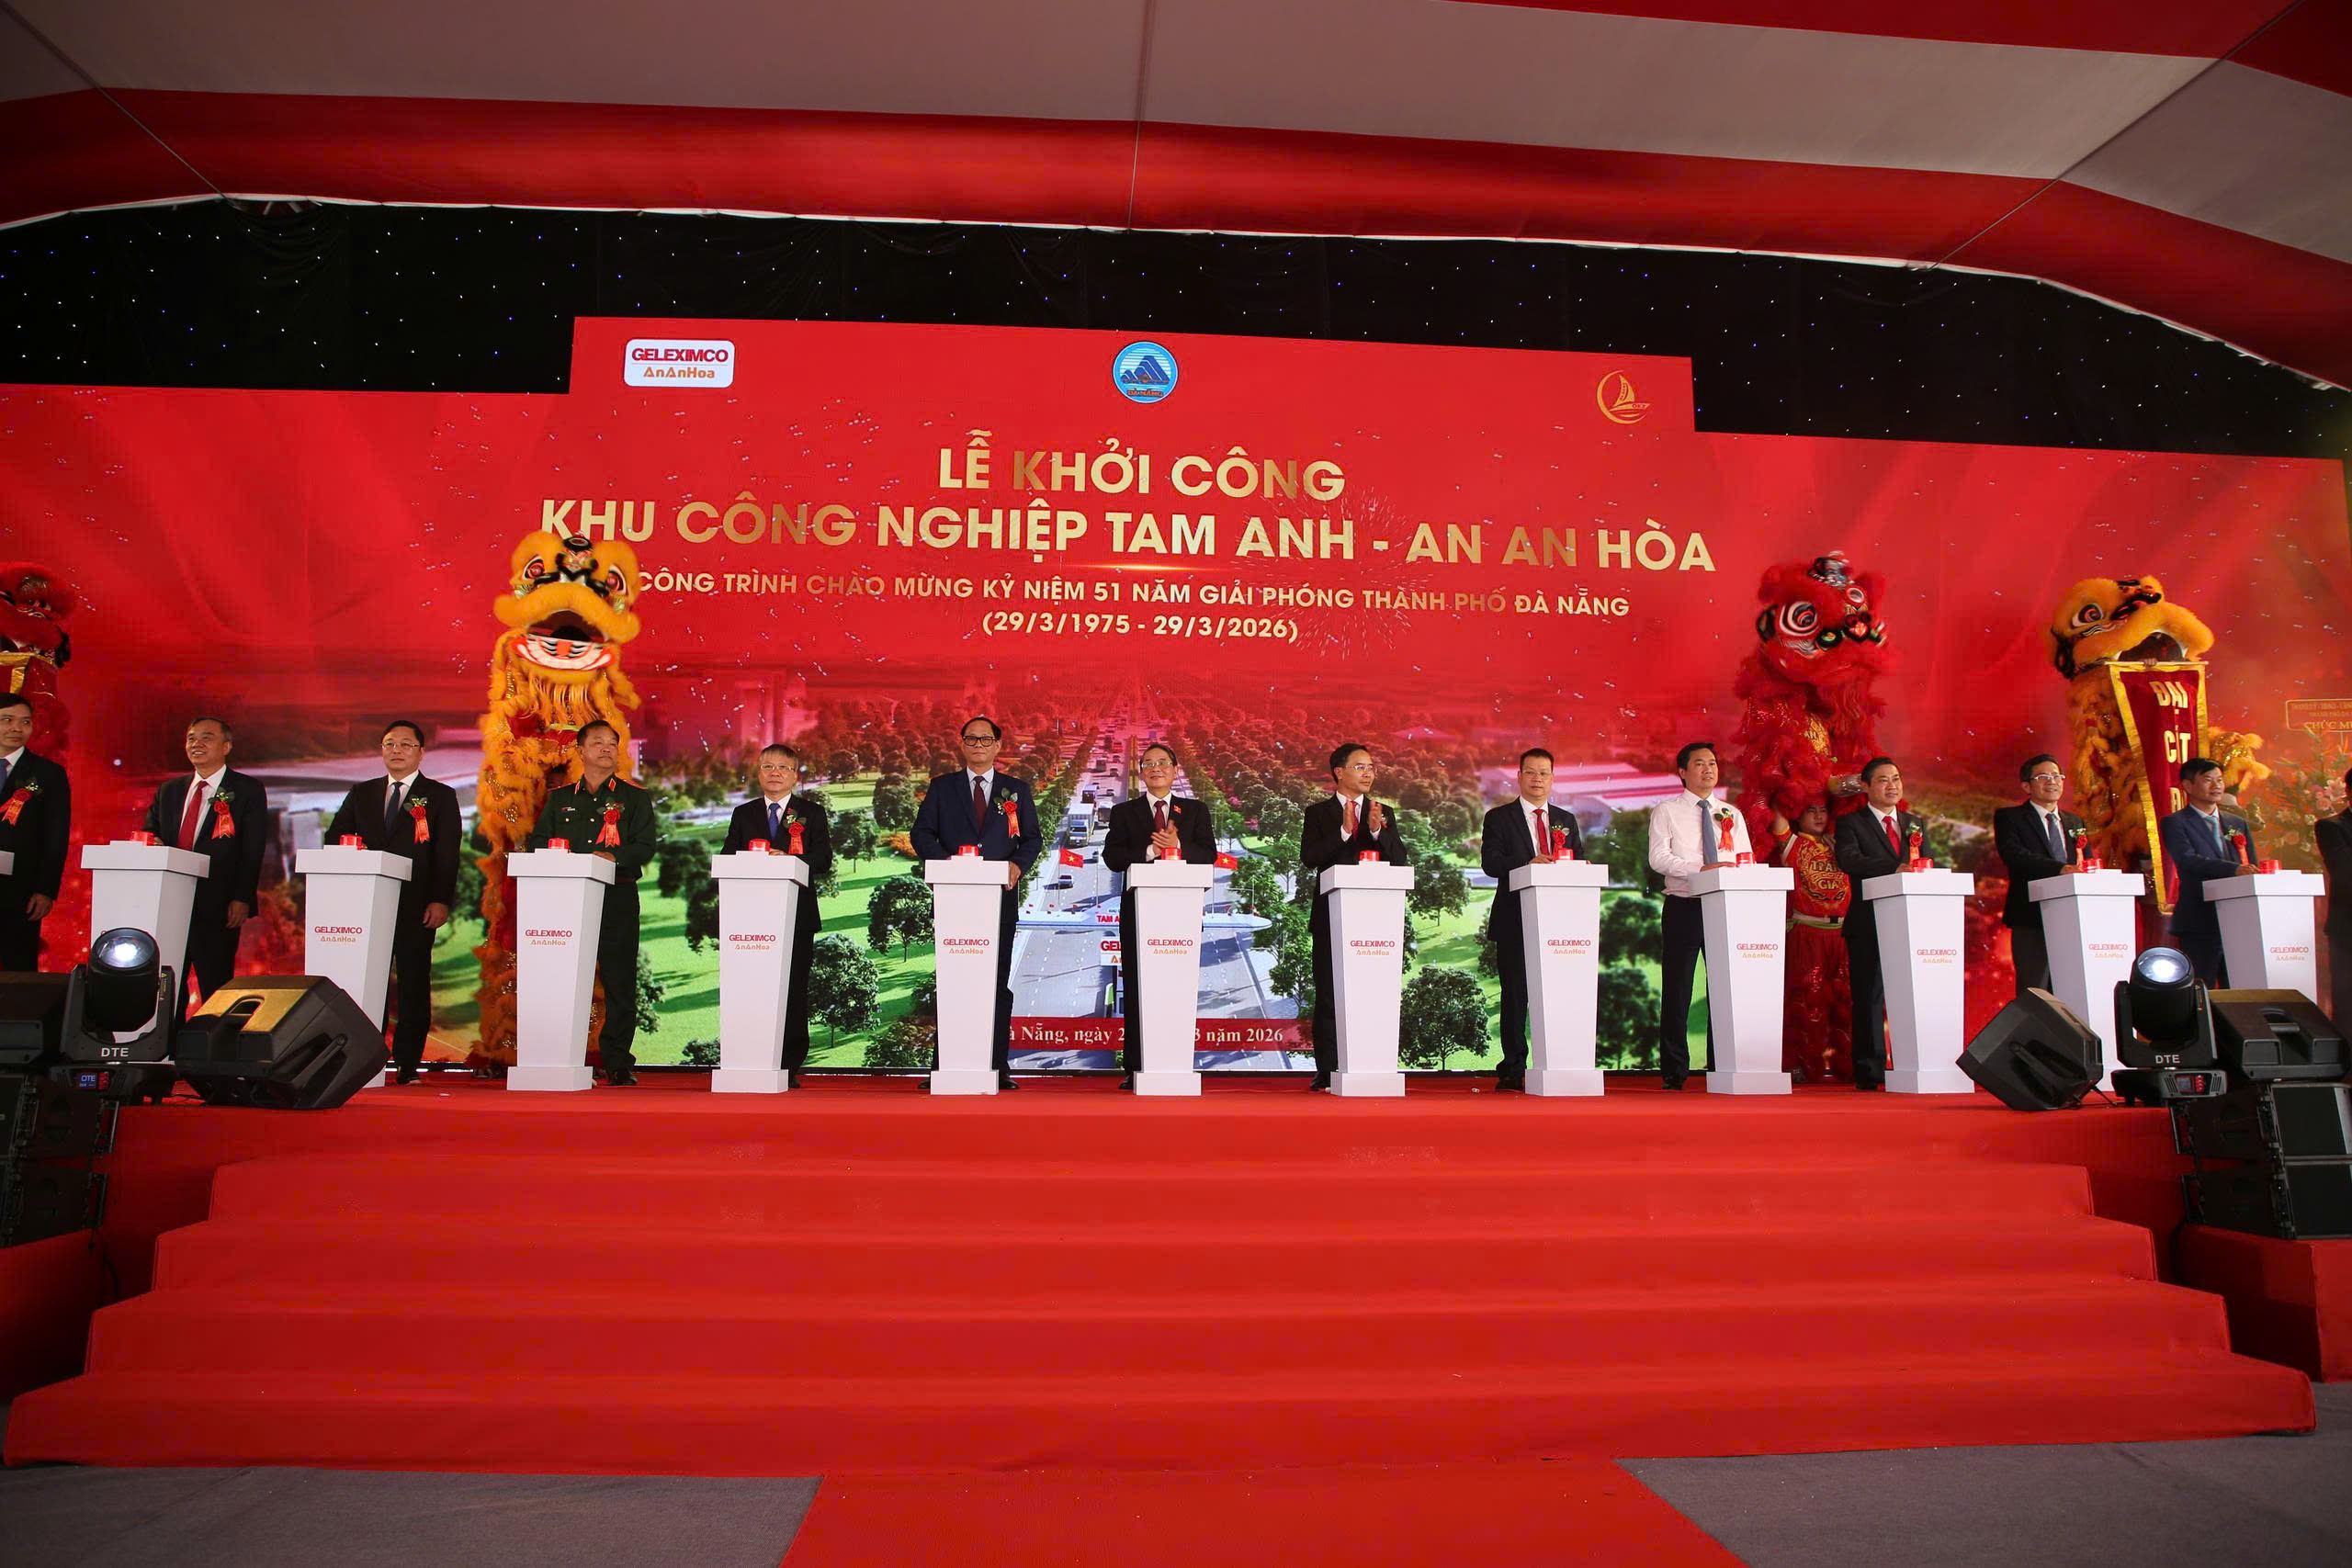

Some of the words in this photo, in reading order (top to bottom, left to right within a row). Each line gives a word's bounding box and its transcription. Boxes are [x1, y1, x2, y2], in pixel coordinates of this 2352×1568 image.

[631, 347, 729, 362] GELEXIMCO
[643, 367, 716, 378] AnAnHoa
[939, 429, 993, 490] LỄ
[1013, 437, 1150, 494] KHỞI
[1170, 446, 1346, 501] CÔNG
[541, 499, 655, 542] KHU
[676, 491, 856, 545] CÔNG
[877, 497, 1088, 563] NGHIỆP
[1104, 512, 1216, 556] TAM
[1235, 516, 1354, 560] ANH
[1373, 540, 1389, 552] -
[1405, 523, 1482, 564] AN
[1501, 526, 1577, 567] AN
[1598, 518, 1716, 572] HÒA
[639, 567, 715, 592] CÔNG
[723, 569, 797, 594] TRÌNH
[805, 572, 885, 596] CHÀO
[895, 573, 973, 599] MỪNG
[983, 572, 1015, 599] KỶ
[1023, 575, 1085, 605] NIỆM
[1093, 581, 1120, 602] 51
[1132, 579, 1191, 604] NĂM
[1199, 579, 1253, 605] GIẢI
[1262, 581, 1354, 609] PHÓNG
[1362, 585, 1445, 612] THÀNH
[1454, 588, 1506, 613] PHỐ
[1514, 589, 1550, 614] ĐÀ
[1555, 587, 1630, 616] NẴNG
[982, 611, 1130, 637] (29/3/1975
[1153, 615, 1298, 644] 29/3/2026)
[314, 926, 363, 934] GELEXIMCO
[525, 929, 572, 937] GELEXIMCO
[1022, 1022, 1069, 1044] Nẵng,
[1074, 1027, 1112, 1044] ngày
[1246, 1028, 1283, 1042] 2026
[101, 1047, 130, 1057] DTE
[2154, 1054, 2181, 1064] DTE
